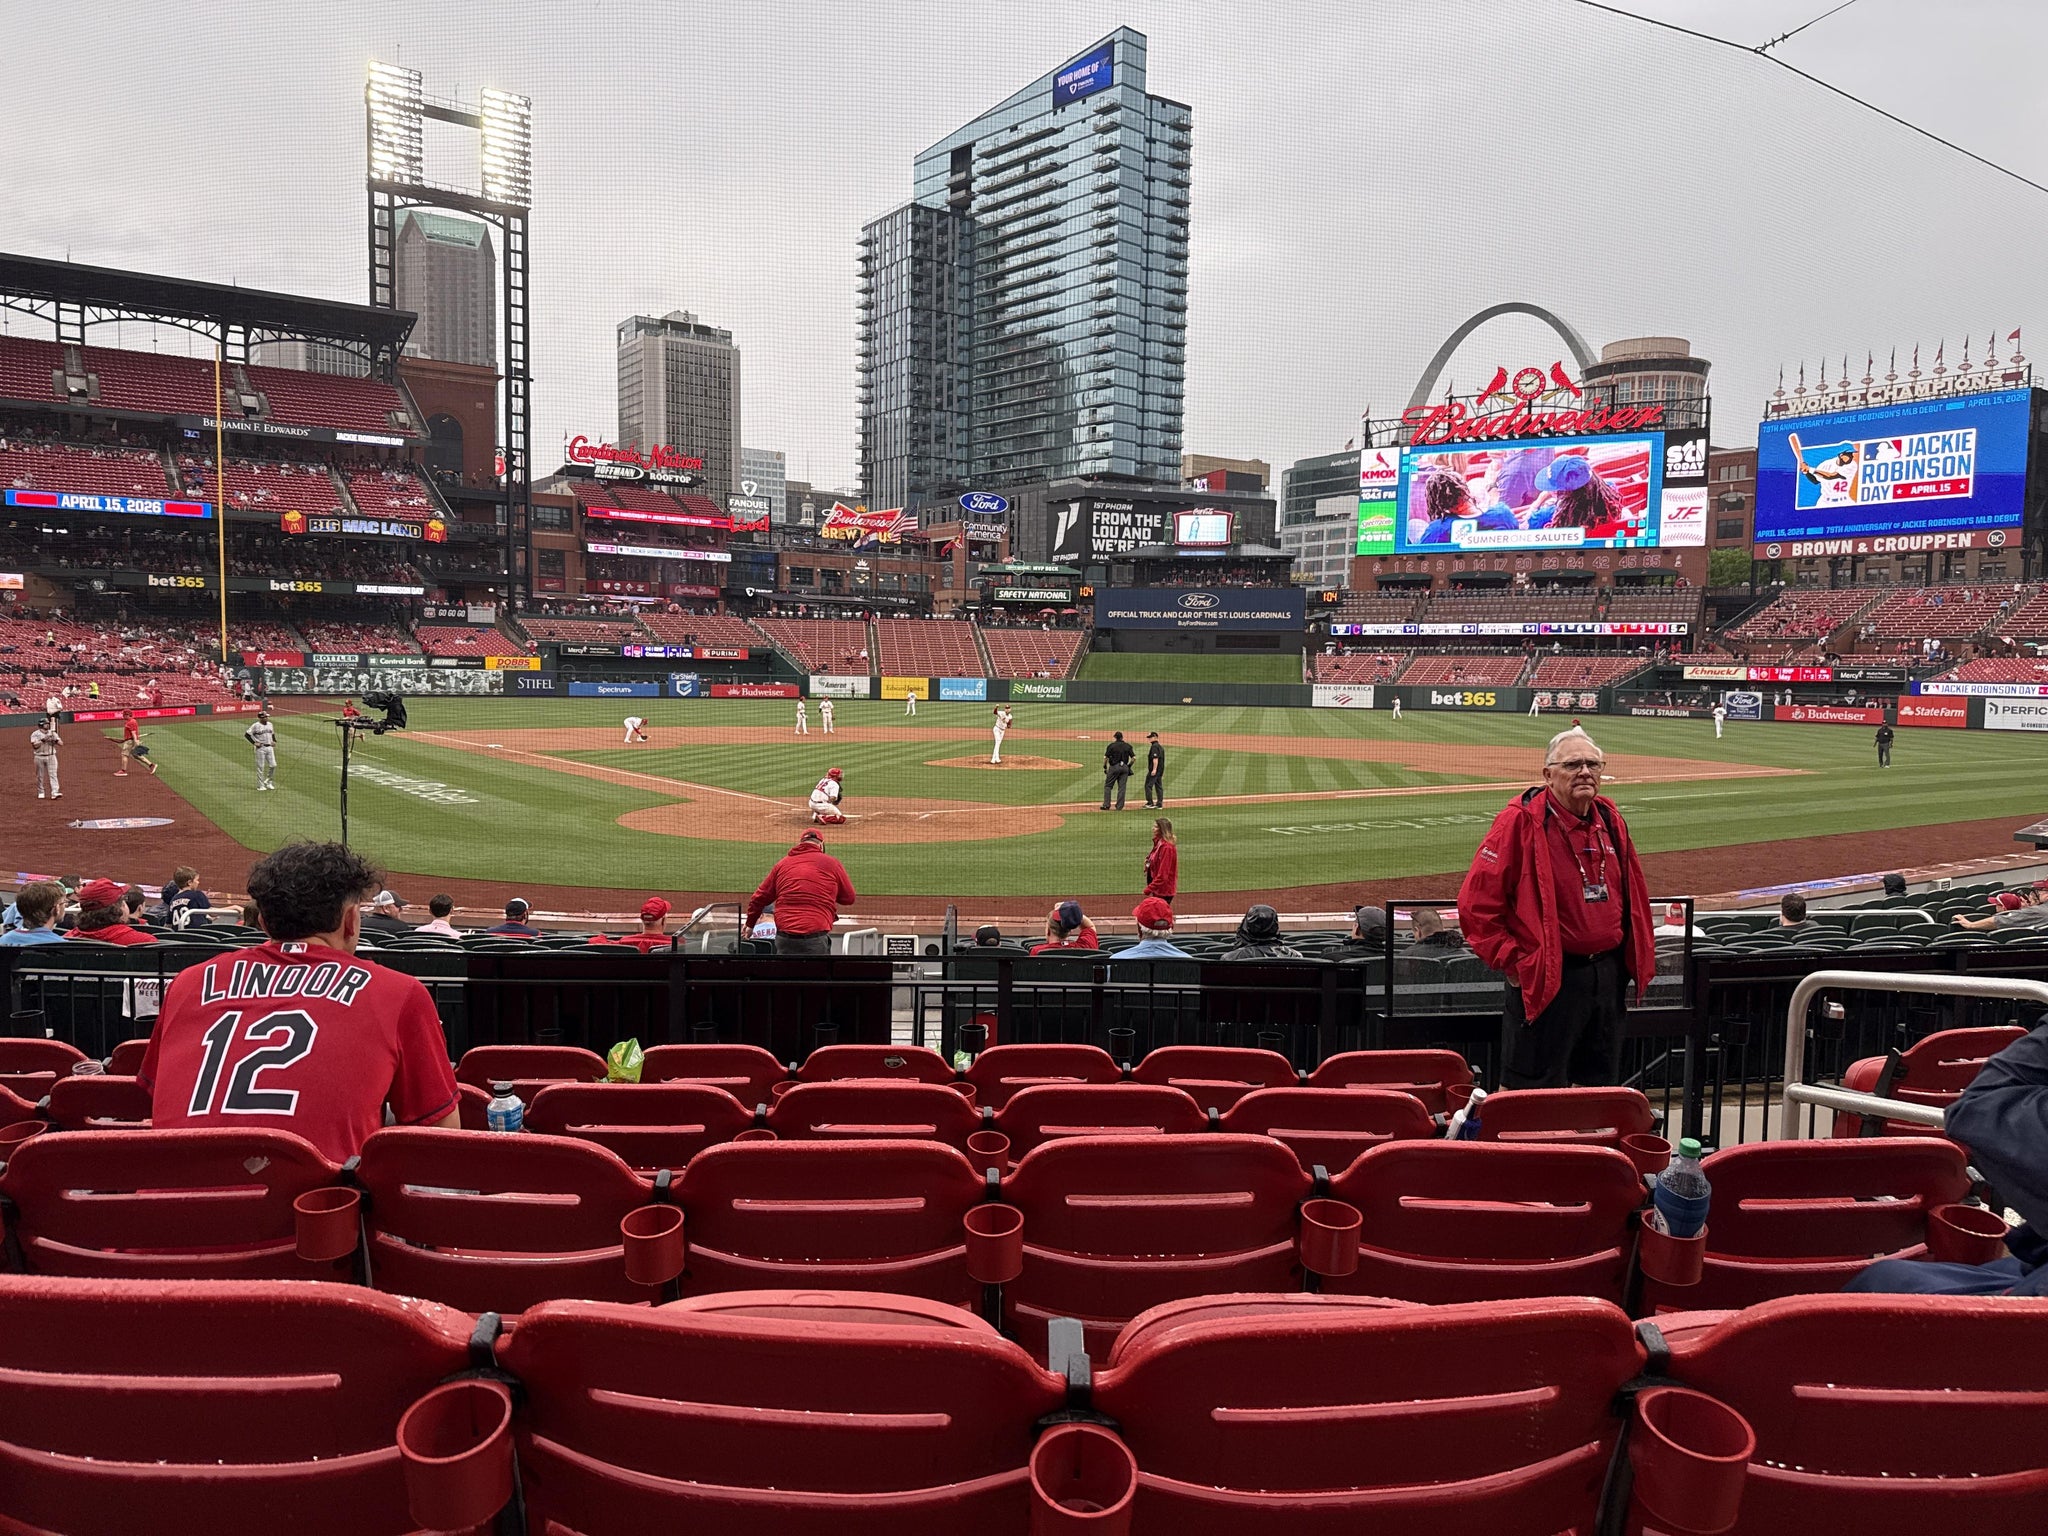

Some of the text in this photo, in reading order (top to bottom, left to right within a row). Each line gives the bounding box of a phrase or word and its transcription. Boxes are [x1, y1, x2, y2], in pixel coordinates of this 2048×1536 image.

[1058, 73, 1074, 87] YOUR
[1074, 67, 1091, 80] HOME
[1092, 62, 1100, 73] OF
[1787, 393, 1861, 412] WORLD
[1867, 373, 2003, 404] CHAMPIONS
[1780, 394, 2027, 431] ANNIVERSARY JACKIE ROBINSON'S MLB DEBUT APRIL 15, 2026
[1402, 396, 1665, 446] Budweiser
[254, 423, 261, 432] F.
[264, 424, 309, 436] EDWARDS
[1667, 439, 1706, 463] stl
[1906, 432, 1972, 458] JACKIE
[569, 435, 702, 469] Cardinals Nation
[1666, 462, 1704, 471] TODAY
[1862, 454, 1971, 484] ROBINSON
[594, 464, 691, 484] HOFFMANN ROOFTOP
[1362, 470, 1396, 480] KMOX
[1833, 481, 1848, 492] 42
[1860, 483, 1950, 502] DAY APRIL 15
[1383, 491, 1396, 499] FM
[61, 496, 161, 513] APRIL 15, 2026
[730, 498, 768, 510] FANDUEL
[970, 494, 999, 510] Ford
[730, 515, 769, 533] Live!
[1093, 512, 1161, 527] FROM THE
[1757, 514, 2019, 538] APRIL 15, ANNIVERSARY JACKIE ROBINSON'S MLB DEBUT
[309, 519, 421, 538] BIG MAC LAND
[822, 528, 856, 540] BREW
[963, 521, 1007, 534] Community
[1093, 525, 1151, 540] LOU AND
[1360, 534, 1393, 542] POWER
[1535, 533, 1579, 542] SALUTES
[1990, 534, 2003, 543] BC
[1092, 539, 1134, 552] WE'RE
[1792, 533, 1972, 557] BROWN & CROUPPEN
[1394, 555, 1661, 573] 1 2 6 9 10 14 17 20 23 24 42 45 85
[149, 575, 204, 588] bet365
[270, 579, 322, 592] bet365
[356, 584, 377, 593] JACKIE
[999, 591, 1066, 599] SAFETY NATIONAL
[1185, 595, 1212, 607] Ford
[1352, 626, 1360, 634] C
[624, 646, 631, 656] C
[407, 658, 426, 666] Bank
[1688, 668, 1741, 676] Schnucks
[517, 677, 555, 689] STIFEL
[1024, 684, 1063, 694] National
[598, 686, 630, 694] Spectrum
[741, 686, 784, 696] Budweiser
[1941, 685, 2036, 695] JACKIE ROBINSON DAY
[1431, 691, 1496, 706] bet365
[1732, 693, 1753, 704] Ford
[1657, 709, 1689, 717] STADIUM
[1808, 708, 1865, 721] Budweiser
[201, 960, 372, 1006] LINDOR
[187, 1010, 318, 1117] 12
